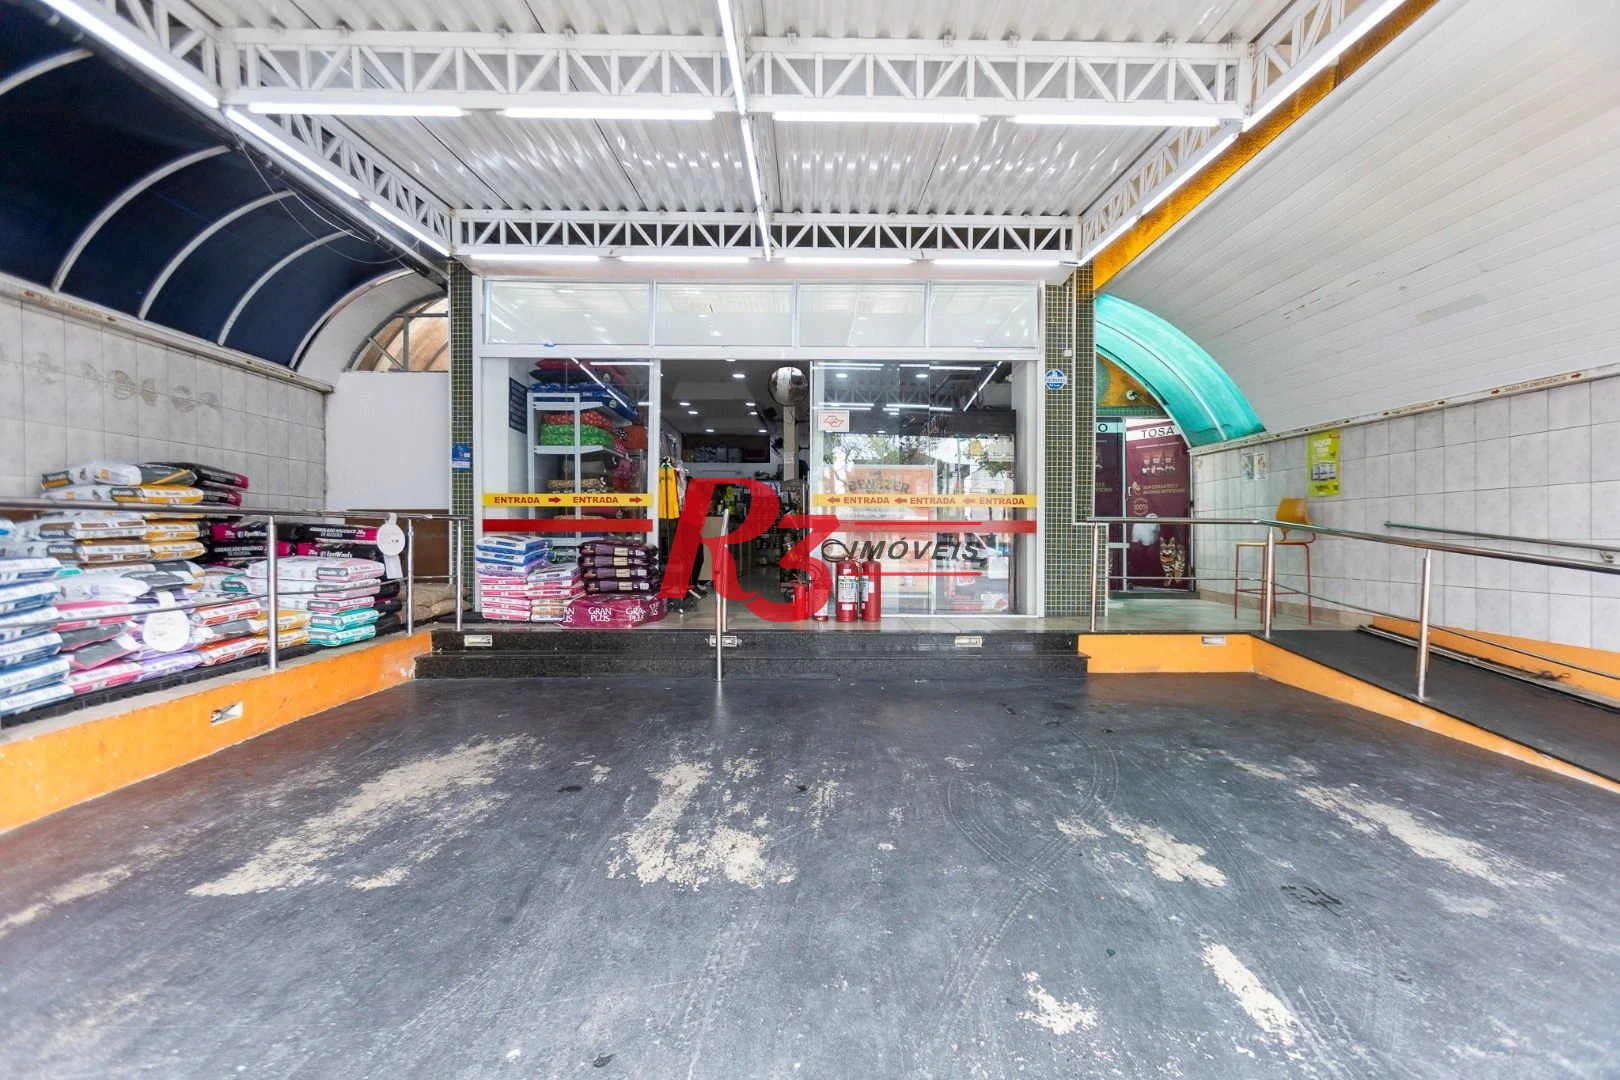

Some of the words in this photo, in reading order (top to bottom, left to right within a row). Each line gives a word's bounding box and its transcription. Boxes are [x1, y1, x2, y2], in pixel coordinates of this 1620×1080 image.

[1142, 426, 1174, 438] TOSA
[494, 496, 540, 504] ENTRADA
[572, 496, 619, 504] ENTRADA
[843, 496, 890, 504] ENTRADA
[910, 497, 956, 505] ENTRADA
[979, 497, 1025, 505] ENTRADA
[588, 607, 612, 615] GRAN
[590, 614, 611, 622] PLUS
